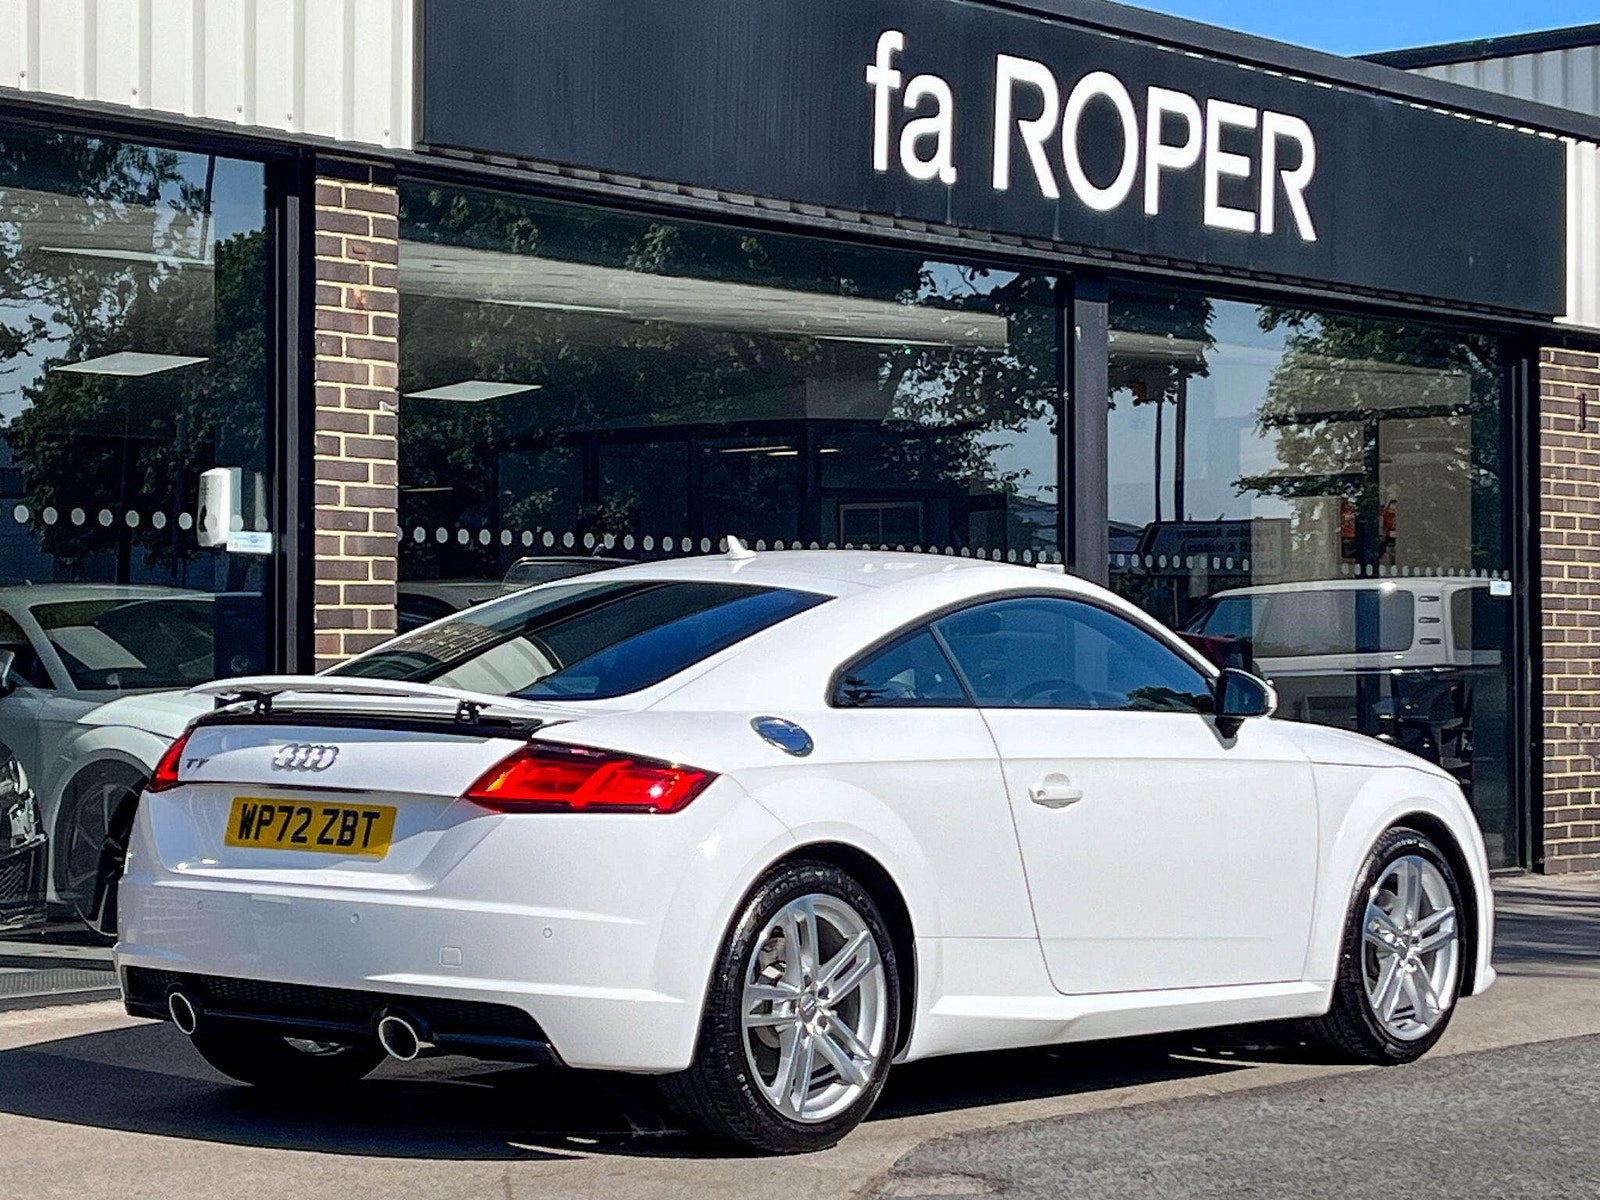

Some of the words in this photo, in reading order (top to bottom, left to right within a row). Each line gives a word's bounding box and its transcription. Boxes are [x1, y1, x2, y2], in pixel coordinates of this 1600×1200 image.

[866, 30, 957, 185] fa
[993, 53, 1317, 242] ROPER
[238, 803, 312, 843] WP72
[316, 808, 381, 848] ZBT
